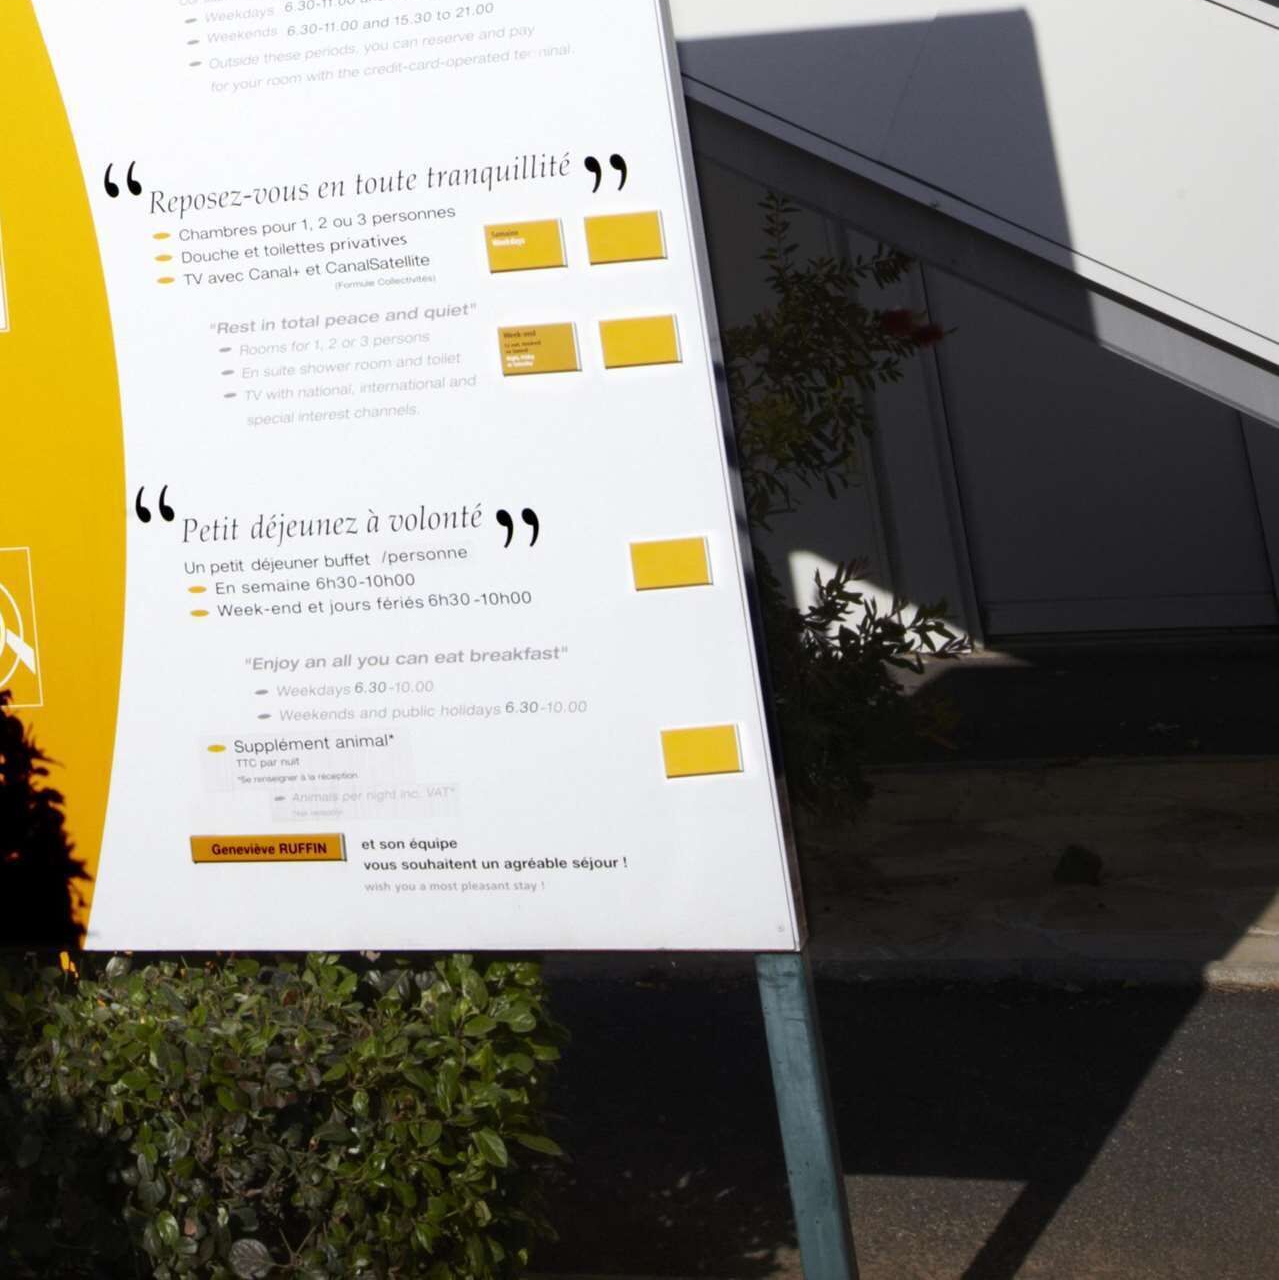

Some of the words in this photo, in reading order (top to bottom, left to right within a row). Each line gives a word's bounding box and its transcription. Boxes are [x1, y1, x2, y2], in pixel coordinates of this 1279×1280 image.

[149, 183, 309, 219] Reposez-vous
[317, 180, 344, 199] en
[355, 169, 417, 195] toute
[427, 151, 570, 192] tranquillité
[178, 225, 257, 241] Chambres
[261, 221, 296, 237] pour
[301, 218, 312, 231] 1,
[317, 216, 327, 229] 2
[332, 216, 352, 228] ou
[356, 212, 367, 226] 3
[371, 207, 456, 226] personnes
[180, 248, 239, 264] Douche
[243, 245, 259, 258] et
[263, 241, 325, 257] toilettes
[329, 235, 407, 254] privatives
[183, 272, 203, 285] TV
[207, 271, 244, 284] avec
[248, 265, 299, 281] Canal+
[304, 263, 321, 276] et
[324, 254, 430, 274] CanalSatellite
[260, 318, 275, 331] in
[280, 314, 319, 329] total
[324, 312, 379, 329] peace
[384, 306, 418, 321] and
[182, 515, 238, 543] Petit
[250, 512, 358, 547] déjeunez
[366, 508, 379, 533] à
[388, 502, 482, 532] volonté
[183, 561, 205, 574] Un
[209, 559, 244, 576] petit
[250, 557, 319, 573] déjeuner
[323, 552, 370, 567] buffet
[381, 547, 467, 565] /personne
[214, 581, 235, 595] En
[240, 580, 310, 594] semaine
[315, 572, 415, 590] 6h30-10h00
[216, 600, 302, 617] Week-end
[307, 600, 324, 613] et
[329, 600, 371, 615] jours
[376, 595, 424, 610] fériés
[304, 657, 326, 669] an
[331, 653, 352, 667] all
[357, 655, 389, 670] you
[394, 653, 428, 665] can
[433, 649, 464, 664] eat
[233, 736, 330, 755] Supplément
[210, 842, 275, 855] Geneviève
[278, 839, 327, 857] RUFFIN
[361, 838, 375, 850] et
[378, 840, 405, 850] son
[408, 839, 457, 851] équipe
[363, 861, 397, 870] vous
[400, 858, 477, 870] souhaitent
[481, 859, 499, 869] un
[503, 857, 567, 872] agréable
[571, 856, 618, 871] séjour
